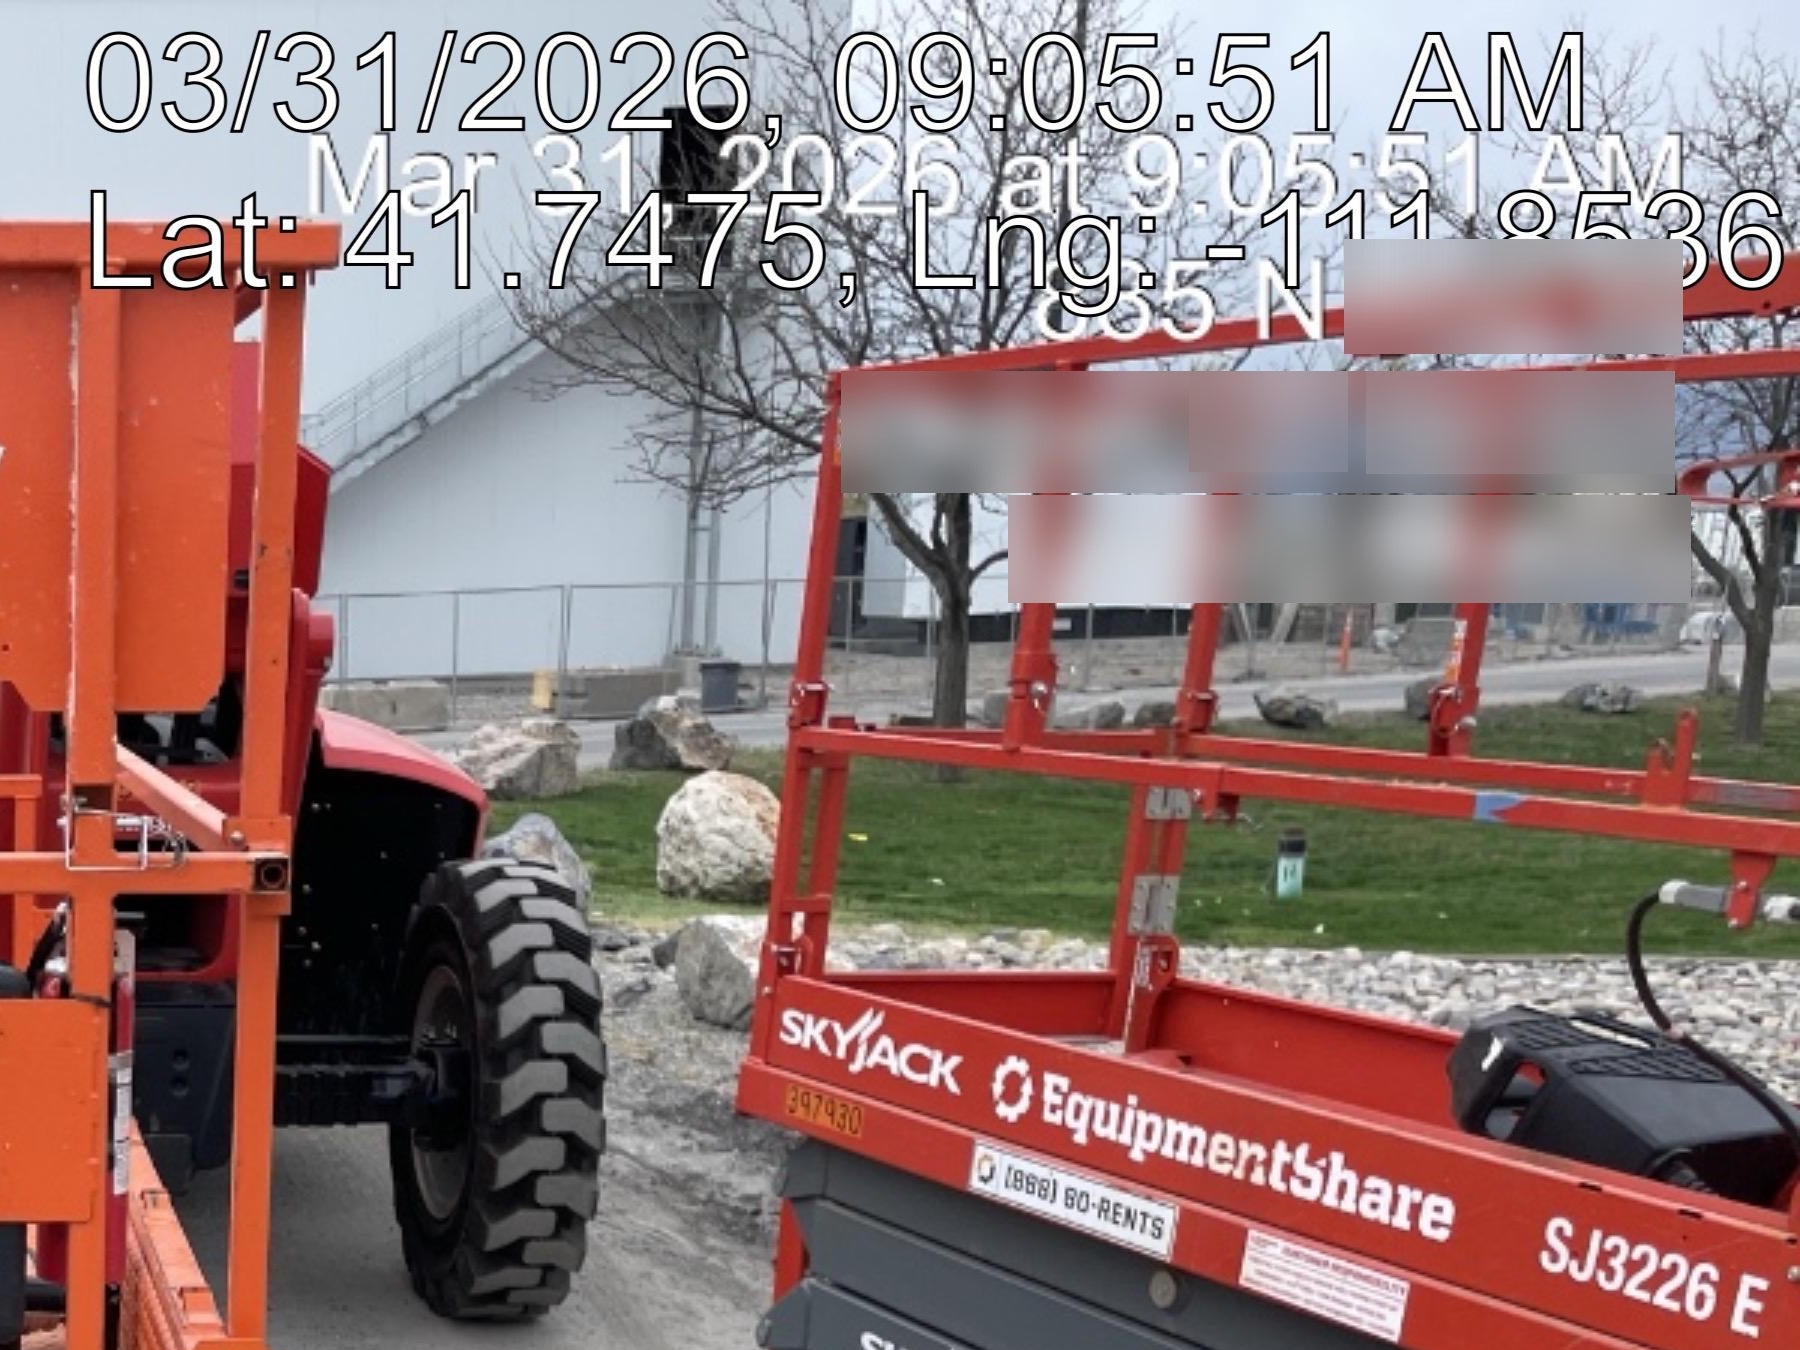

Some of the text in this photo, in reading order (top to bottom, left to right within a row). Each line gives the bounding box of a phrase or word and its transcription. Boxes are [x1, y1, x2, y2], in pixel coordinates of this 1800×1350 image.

[779, 1007, 1455, 1242] SKYJACK EquipmentShare
[1540, 1217, 1771, 1339] SJ3226 E
